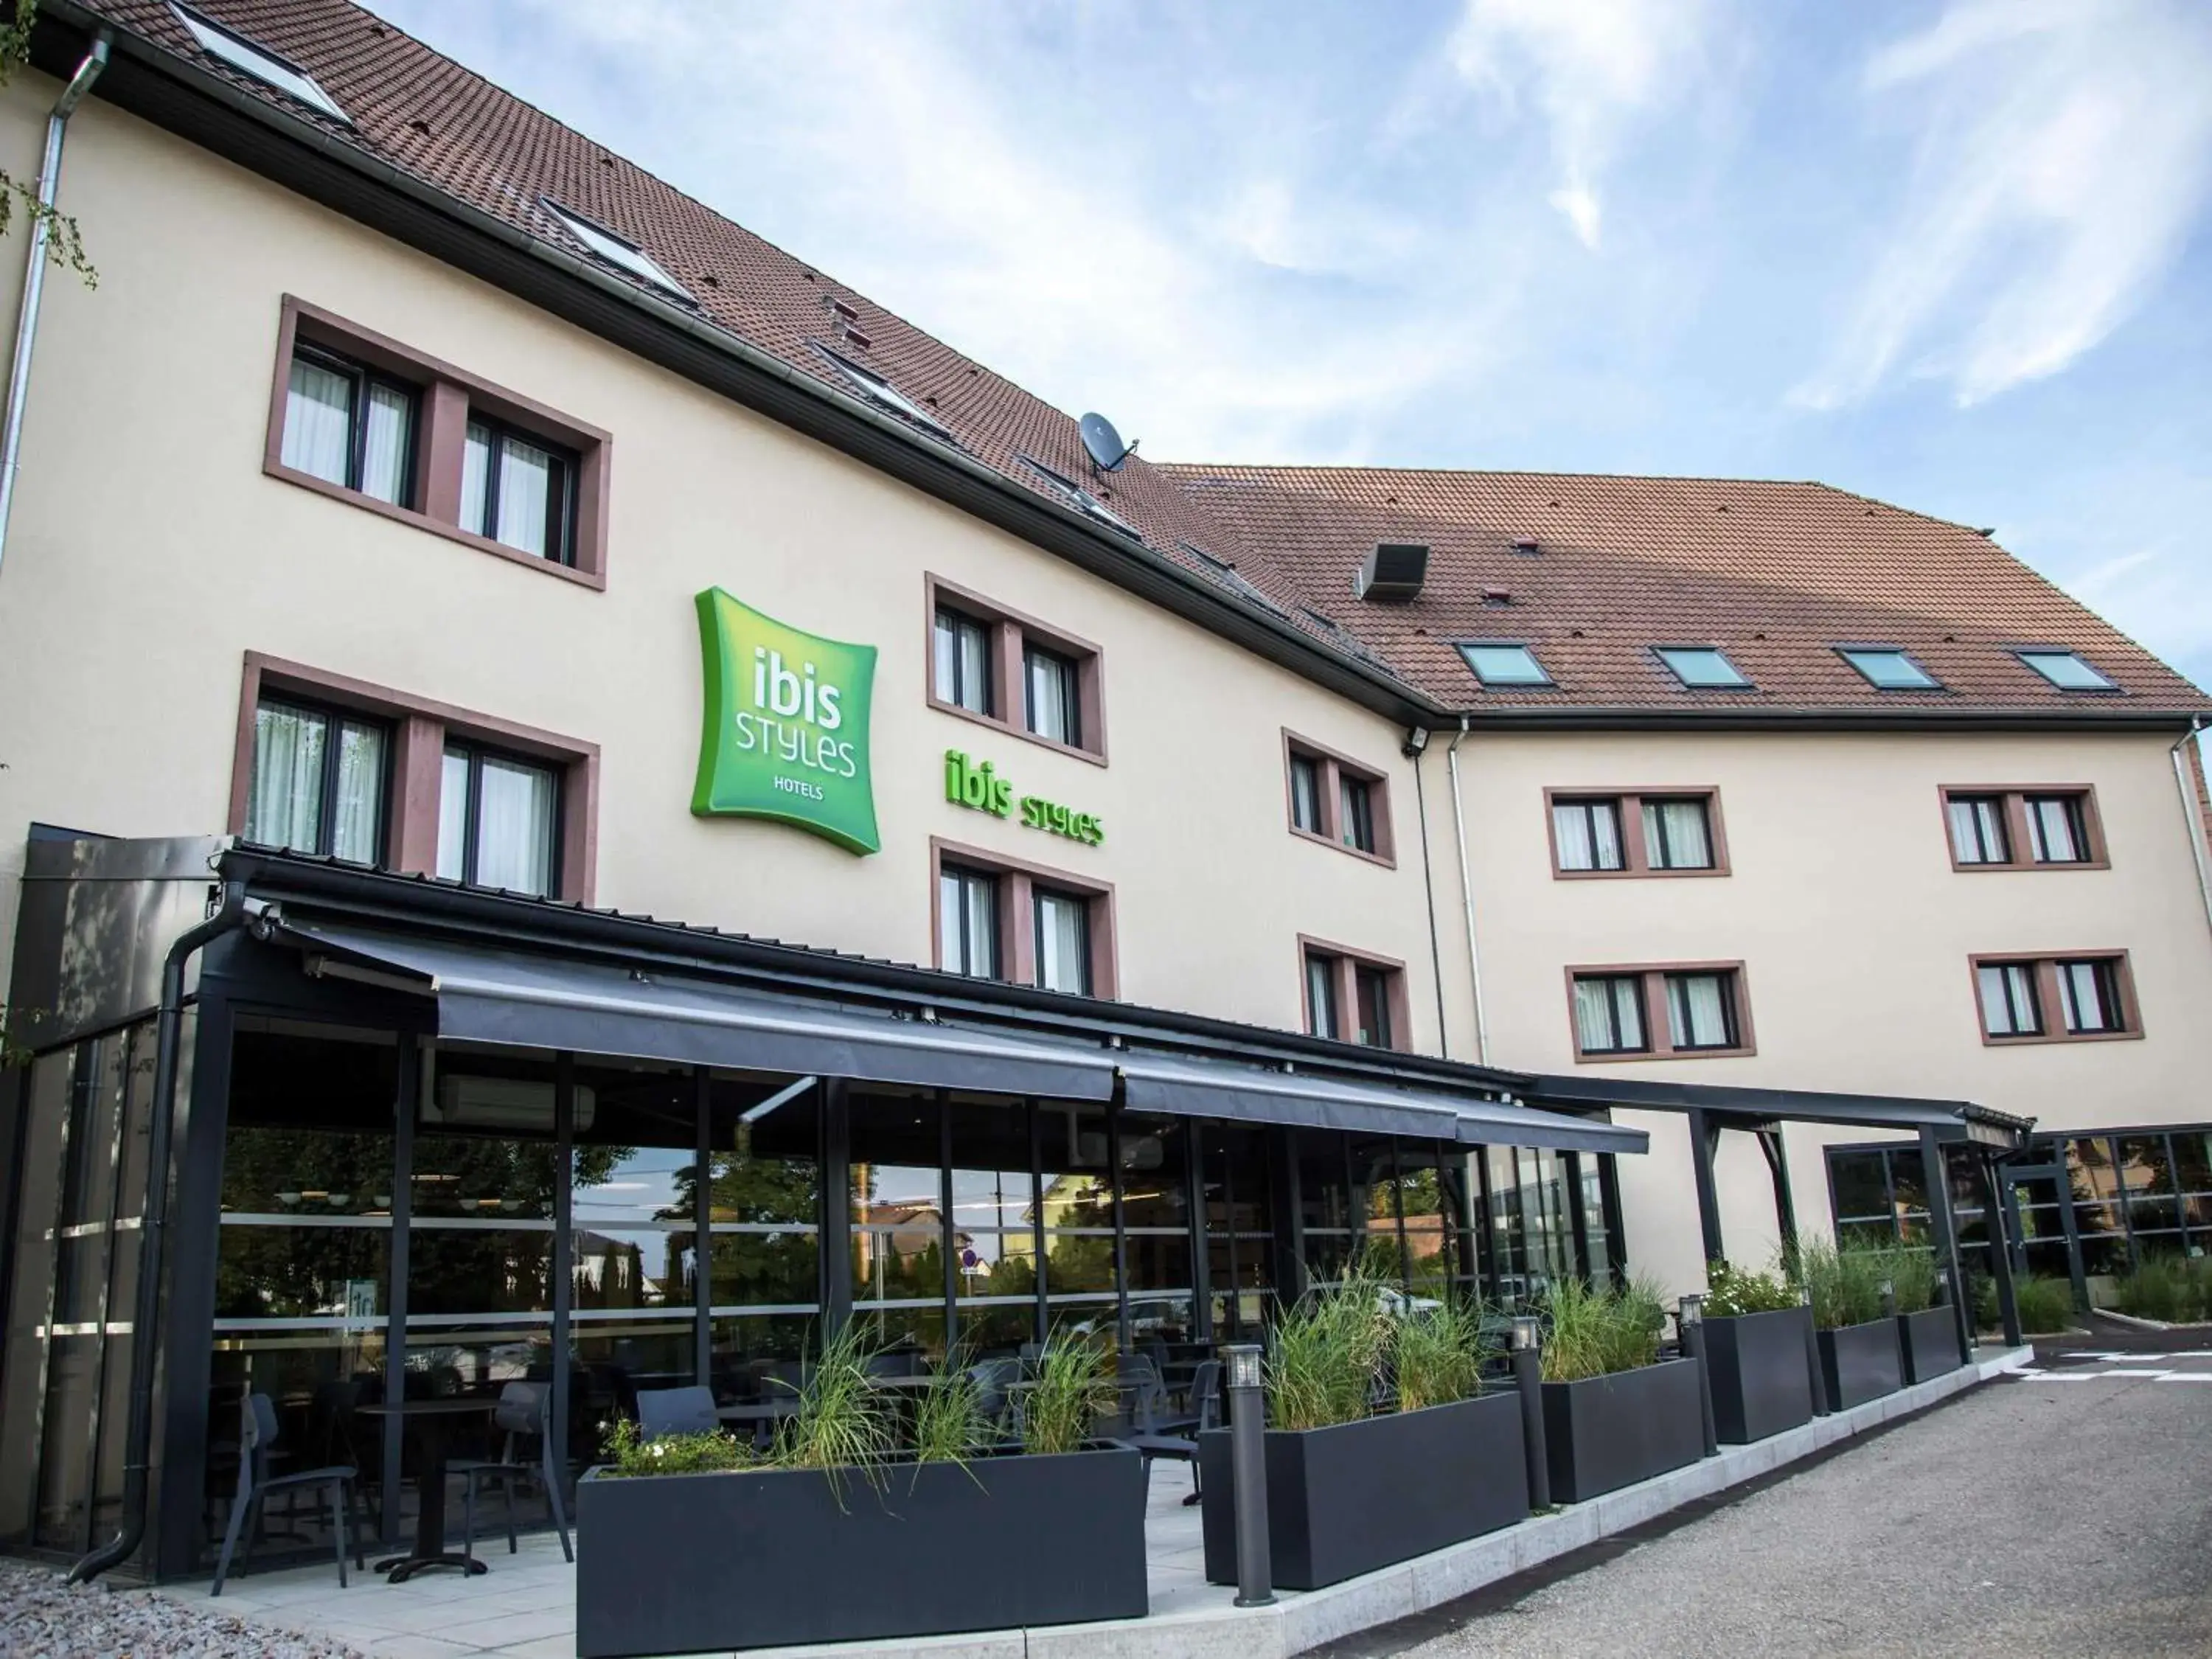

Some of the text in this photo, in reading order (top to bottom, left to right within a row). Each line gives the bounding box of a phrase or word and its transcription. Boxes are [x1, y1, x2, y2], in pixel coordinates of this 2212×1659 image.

[755, 647, 841, 729] ibis
[775, 776, 824, 800] HOTELS
[945, 749, 1013, 819] ibis
